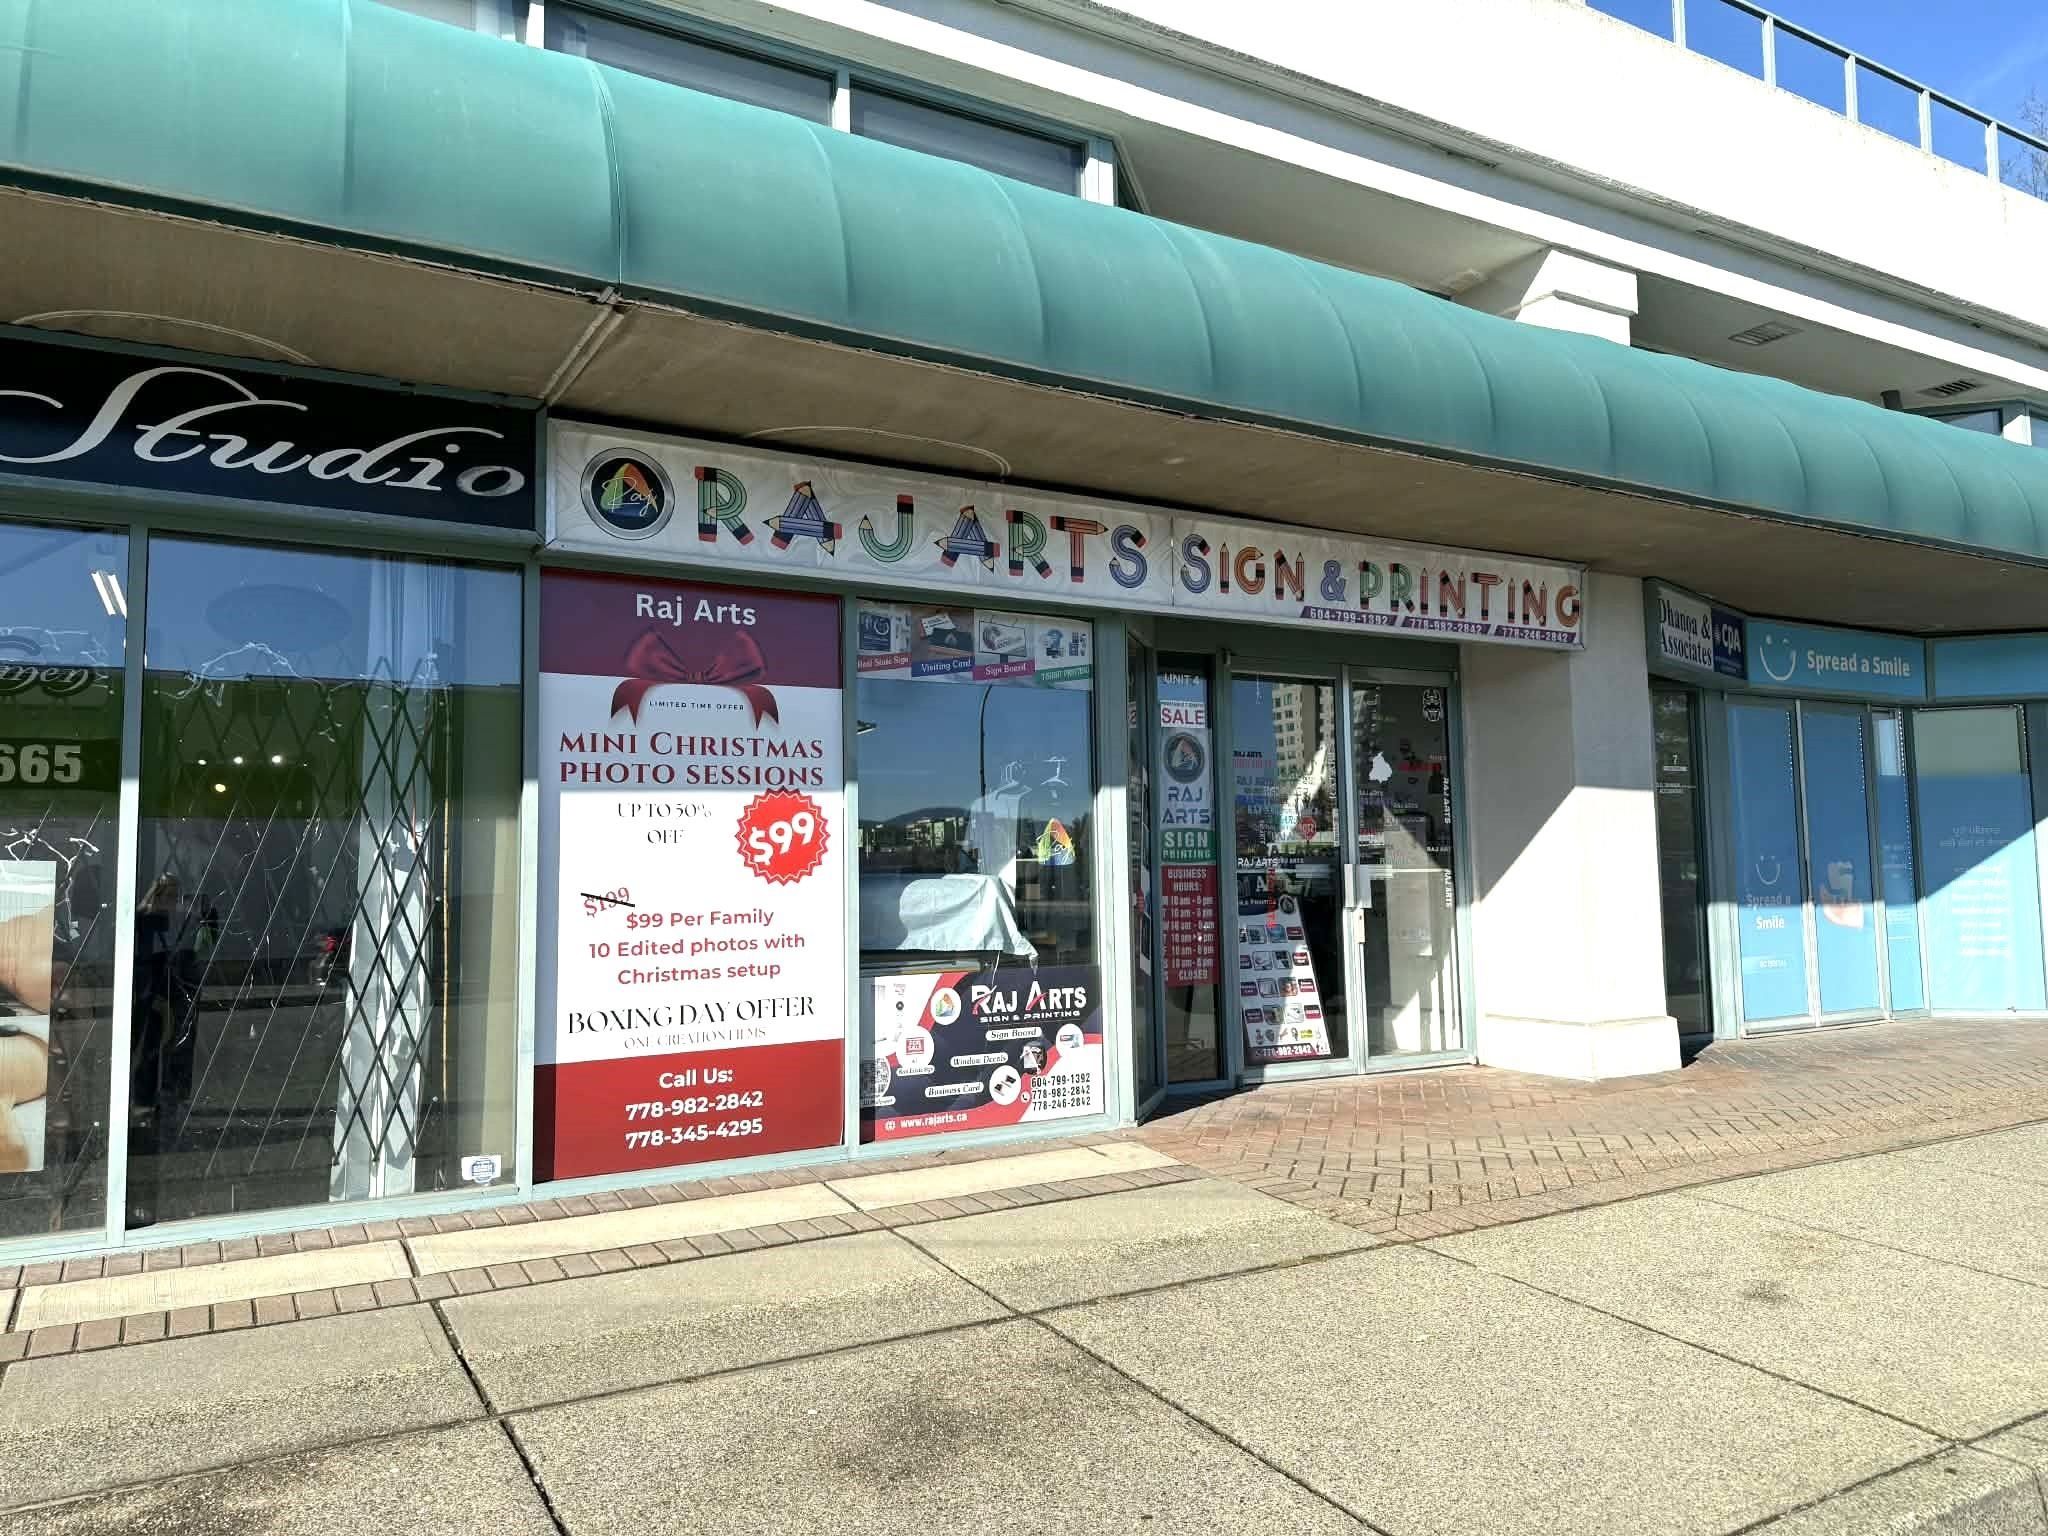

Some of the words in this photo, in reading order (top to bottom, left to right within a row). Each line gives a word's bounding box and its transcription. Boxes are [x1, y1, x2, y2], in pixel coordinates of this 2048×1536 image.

[0, 366, 525, 496] Studio
[694, 464, 914, 563] RAJ
[933, 504, 1148, 589] ARTS
[1180, 533, 1304, 602] SIGN
[1320, 559, 1347, 601] &
[1358, 559, 1580, 627] PRINTING
[636, 593, 683, 626] Raj
[693, 599, 757, 626] Arts
[1701, 614, 1711, 640] &
[1660, 623, 1712, 666] Associates
[1807, 650, 1857, 675] Spread
[1861, 658, 1870, 673] a
[1873, 656, 1911, 677] Smile
[649, 700, 687, 708] LIMITED
[690, 702, 712, 710] TIME
[1161, 708, 1205, 725] SALE
[559, 732, 638, 755] MINI
[650, 731, 823, 759] CHRISTMAS
[559, 762, 675, 784] PHOTO
[686, 764, 824, 786] SESSIONS
[1168, 786, 1202, 801] RAJ
[648, 802, 671, 818] TO
[1161, 808, 1210, 825] ARTS
[647, 829, 686, 845] OFF
[748, 811, 815, 866] $99
[1164, 831, 1208, 848] SIGN
[584, 887, 631, 917] $199
[1745, 893, 1782, 910] Spread
[627, 911, 663, 931] $99
[670, 912, 704, 927] Per
[710, 908, 774, 927] Family
[1756, 915, 1785, 929] Smile
[589, 942, 610, 959] 10
[618, 938, 684, 957] Edited
[690, 936, 758, 957] photos
[764, 934, 805, 950] with
[618, 965, 721, 985] Christmas
[727, 962, 781, 979] setup
[972, 984, 1018, 1015] RAJ
[1025, 980, 1087, 1012] ARTS
[568, 1006, 672, 1034] BOXING
[680, 1001, 731, 1026] DAY
[737, 996, 815, 1021] OFFER
[980, 1015, 1010, 1023] SIGN
[1024, 1010, 1081, 1021] PRINTING
[991, 1030, 1009, 1039] Sign
[659, 1069, 696, 1089] Call
[704, 1067, 733, 1085] Us:
[1031, 1073, 1091, 1088] 604-799-1392
[1032, 1085, 1091, 1100] 778-982-2842
[1033, 1096, 1091, 1112] 778-246-2842
[625, 1090, 763, 1121] 778-982-2842
[900, 1112, 968, 1128] www.rajarts.ca
[625, 1117, 763, 1150] 778-345-4295
